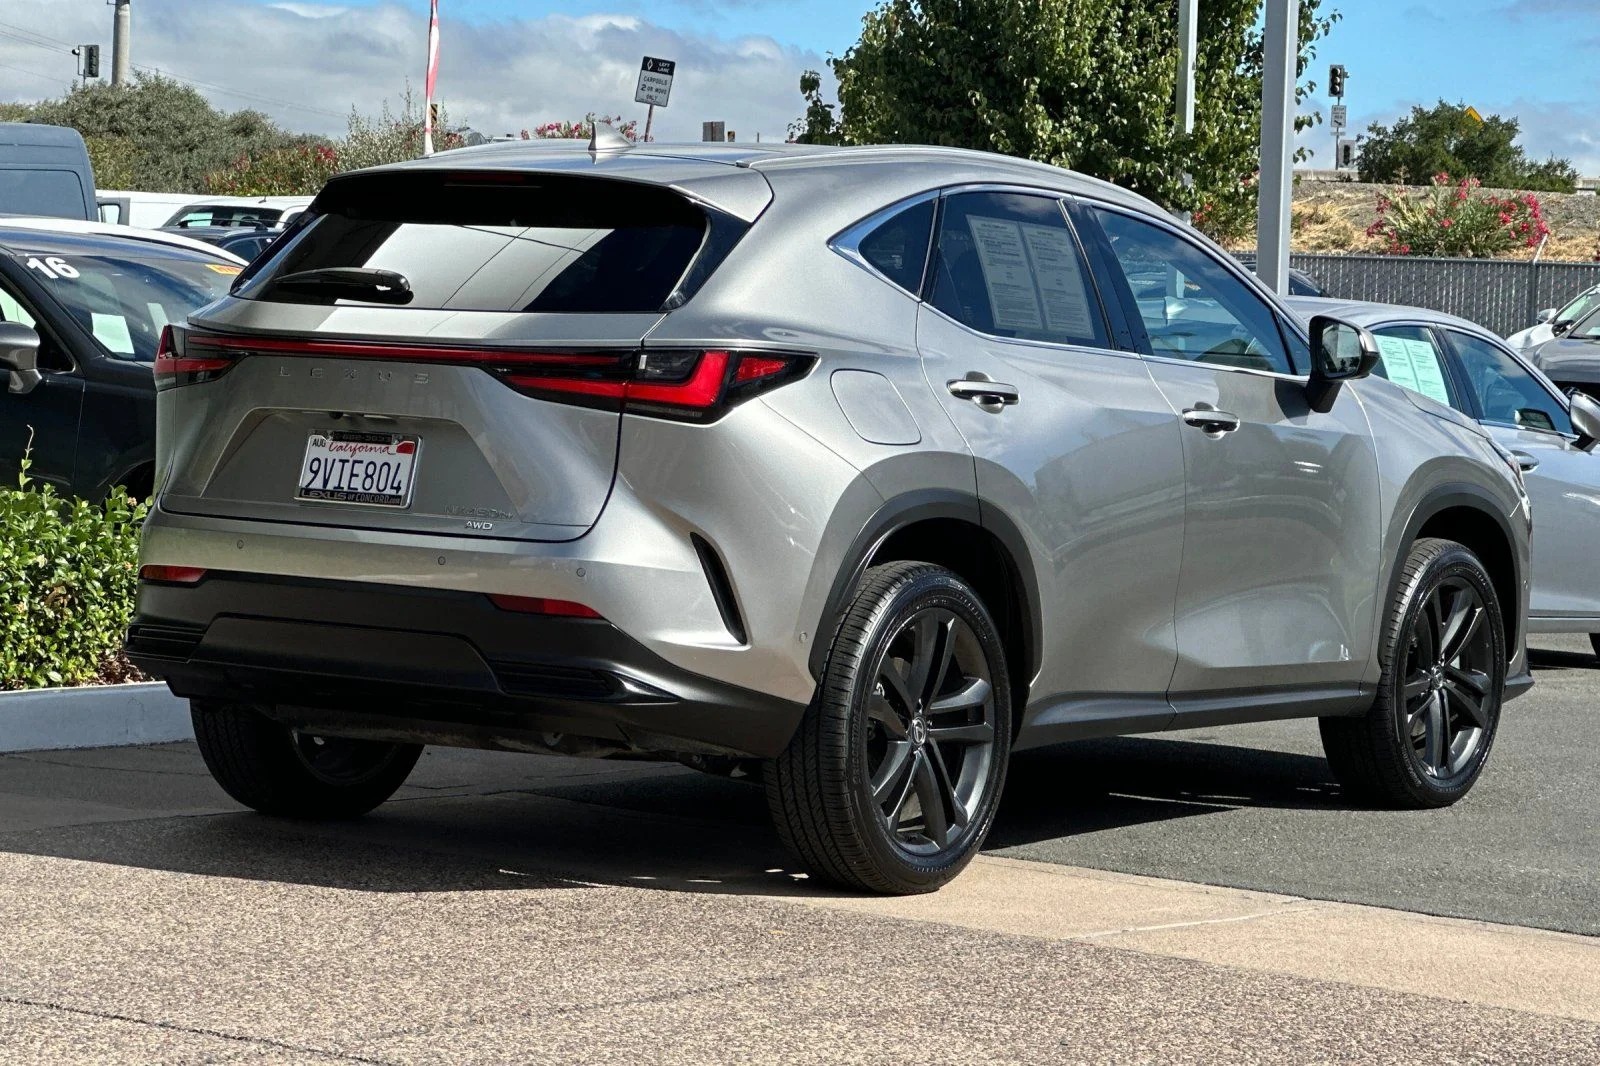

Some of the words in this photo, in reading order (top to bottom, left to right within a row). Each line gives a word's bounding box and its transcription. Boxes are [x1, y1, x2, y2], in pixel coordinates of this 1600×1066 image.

[640, 83, 647, 92] 2
[26, 257, 80, 279] 16
[280, 366, 429, 385] LEXUS
[312, 438, 326, 447] AUG
[329, 441, 391, 458] California
[305, 456, 402, 495] 9VIE804
[301, 489, 347, 500] LEXUS
[465, 520, 493, 530] AWD
